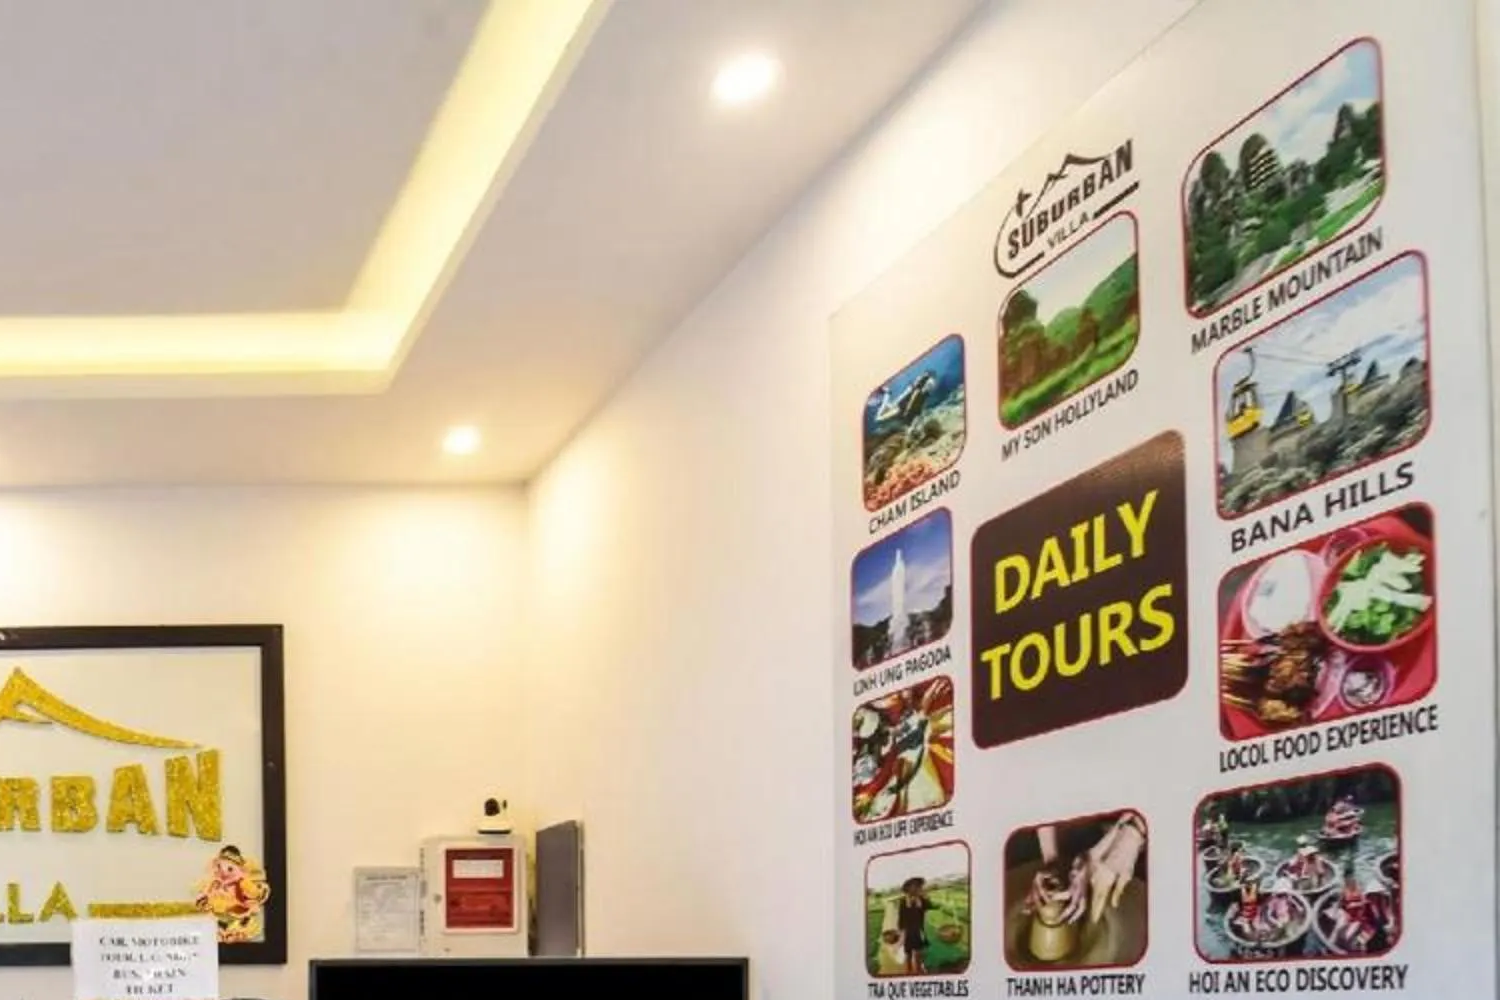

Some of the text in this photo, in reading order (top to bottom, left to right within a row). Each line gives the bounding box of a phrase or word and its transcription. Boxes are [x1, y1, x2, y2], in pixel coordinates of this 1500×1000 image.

[1008, 138, 1133, 260] SUBURBAN
[1047, 211, 1090, 249] VILLA
[1191, 225, 1383, 353] MARBLE MOUNTAIN
[1001, 368, 1139, 462] MY SON HOLLYLAND
[868, 469, 961, 535] CHAM ISLAND
[1230, 460, 1414, 554] BANA HILLS
[994, 491, 1159, 615] DAILY
[879, 663, 903, 686] UNG
[905, 644, 952, 675] PAGODA
[980, 583, 1176, 701] TOURS
[1219, 703, 1438, 773] LOCOL FOOD EXPERIENCE
[868, 982, 886, 998] TRA
[908, 979, 970, 998] VEGETABLES
[1006, 973, 1146, 997] THANH HA POTTERY
[1188, 964, 1409, 994] HOI AN ECO DISCOVERY
